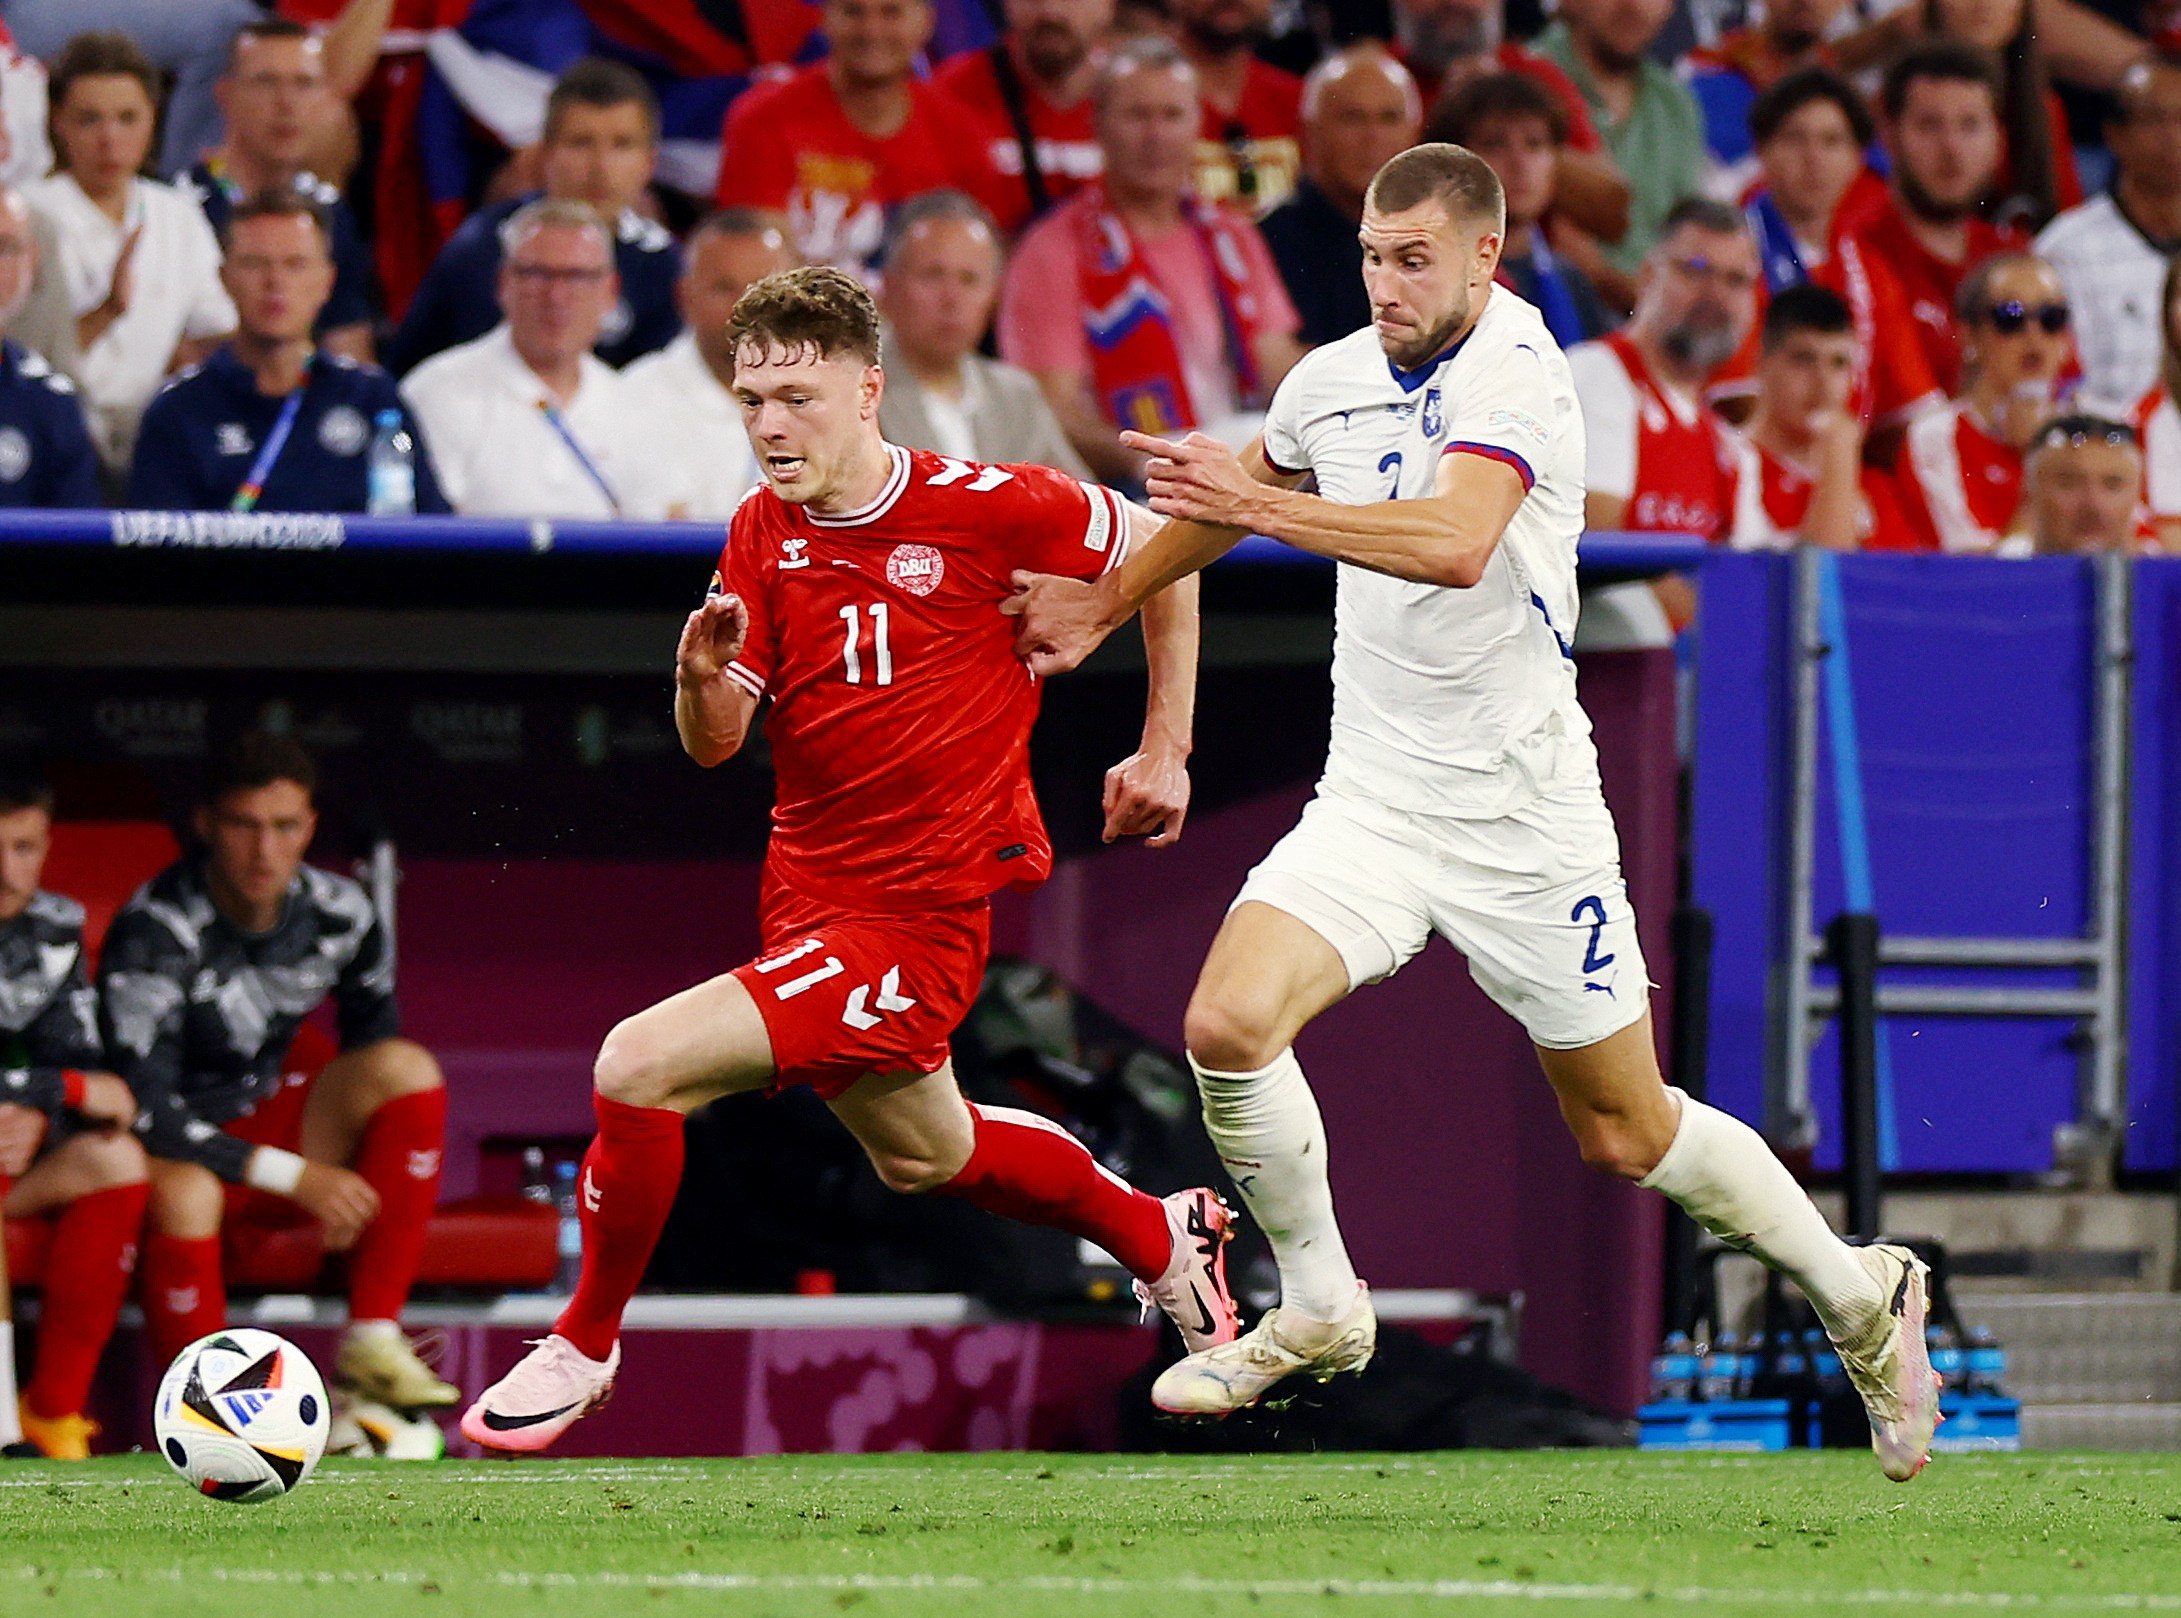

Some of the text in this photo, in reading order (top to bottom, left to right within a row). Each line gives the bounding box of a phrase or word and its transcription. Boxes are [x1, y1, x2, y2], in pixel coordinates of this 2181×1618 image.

[897, 557, 933, 578] DBU
[839, 602, 893, 686] 11
[1571, 895, 1615, 974] 2
[754, 939, 845, 1001] 11
